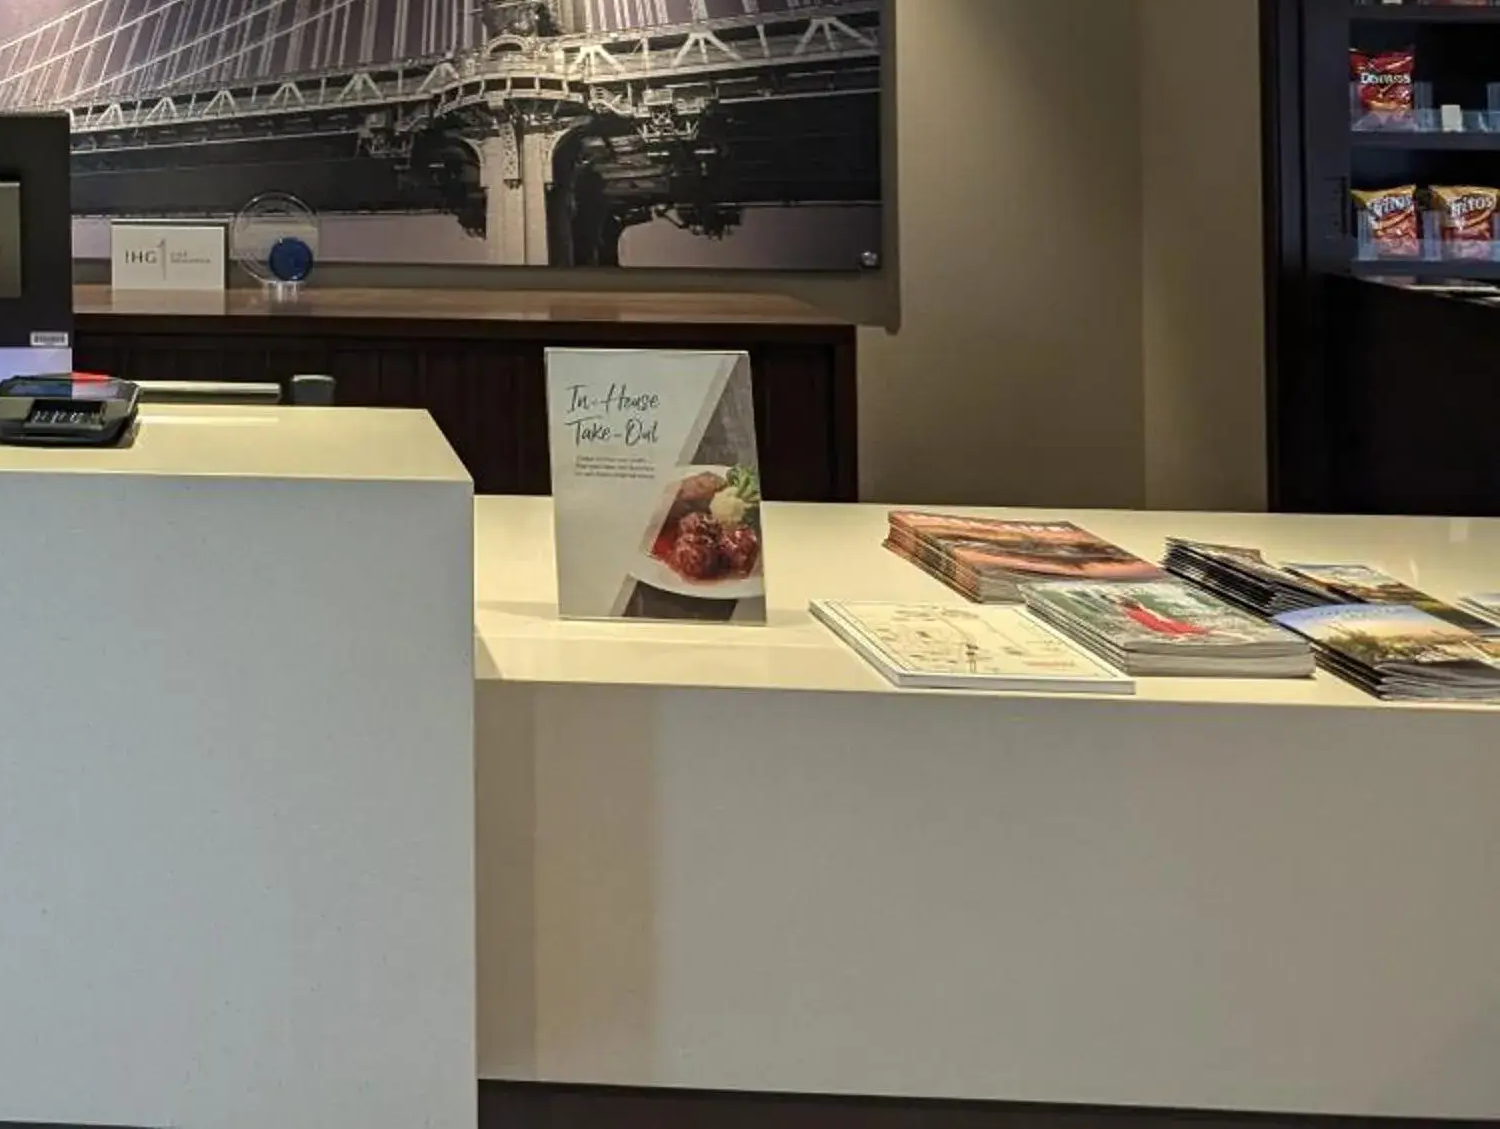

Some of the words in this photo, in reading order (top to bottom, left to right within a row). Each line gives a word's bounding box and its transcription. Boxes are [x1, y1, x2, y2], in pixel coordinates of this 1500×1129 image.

[125, 250, 158, 264] IHG
[564, 383, 660, 413] In-House
[563, 416, 659, 447] Take-Out
